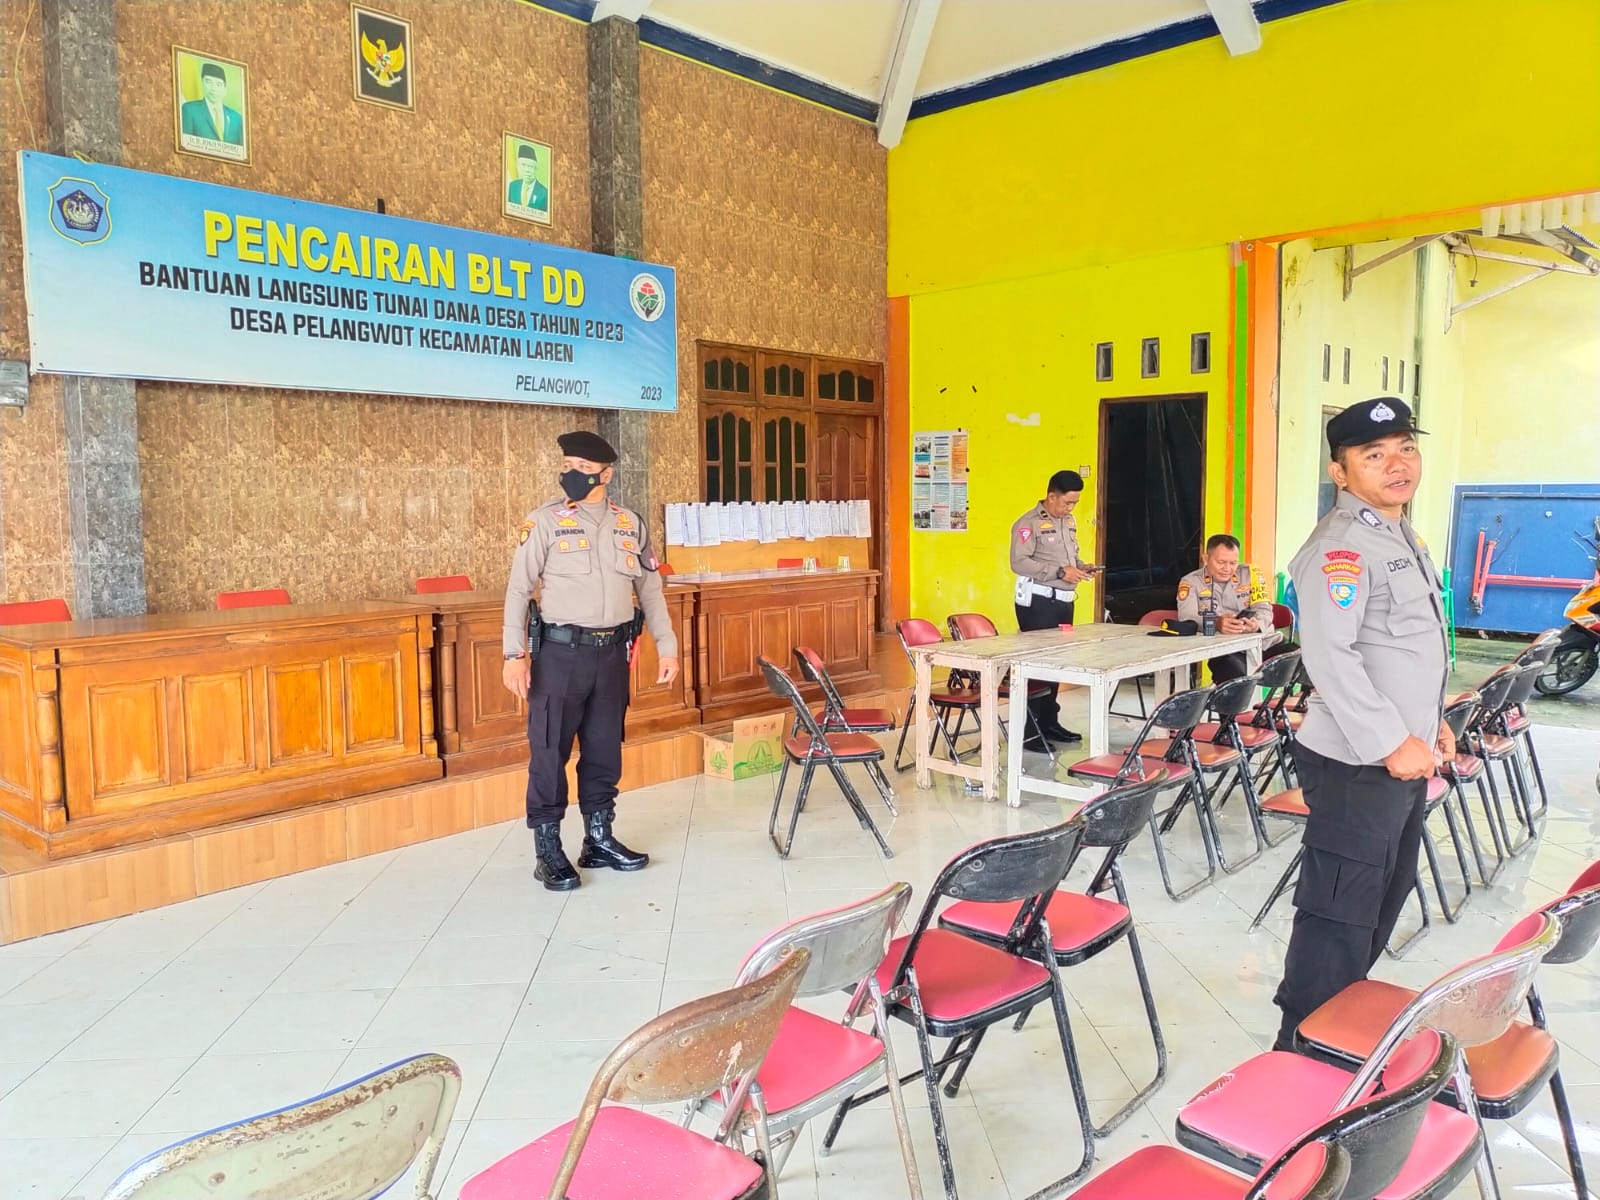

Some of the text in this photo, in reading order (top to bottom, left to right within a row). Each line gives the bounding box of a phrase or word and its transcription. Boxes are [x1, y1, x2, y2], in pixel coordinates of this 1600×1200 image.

[203, 209, 585, 308] PENCAIRAN BLT DD
[139, 261, 624, 342] BANTUAN LANGSUNG TUNAI DANA DESA TAHUN 2023
[230, 307, 574, 363] DESA PELANGWOT KECAMATAN LAREN
[515, 374, 590, 398] PELANGWOT,
[640, 385, 662, 401] 2023
[613, 528, 638, 539] POLRI
